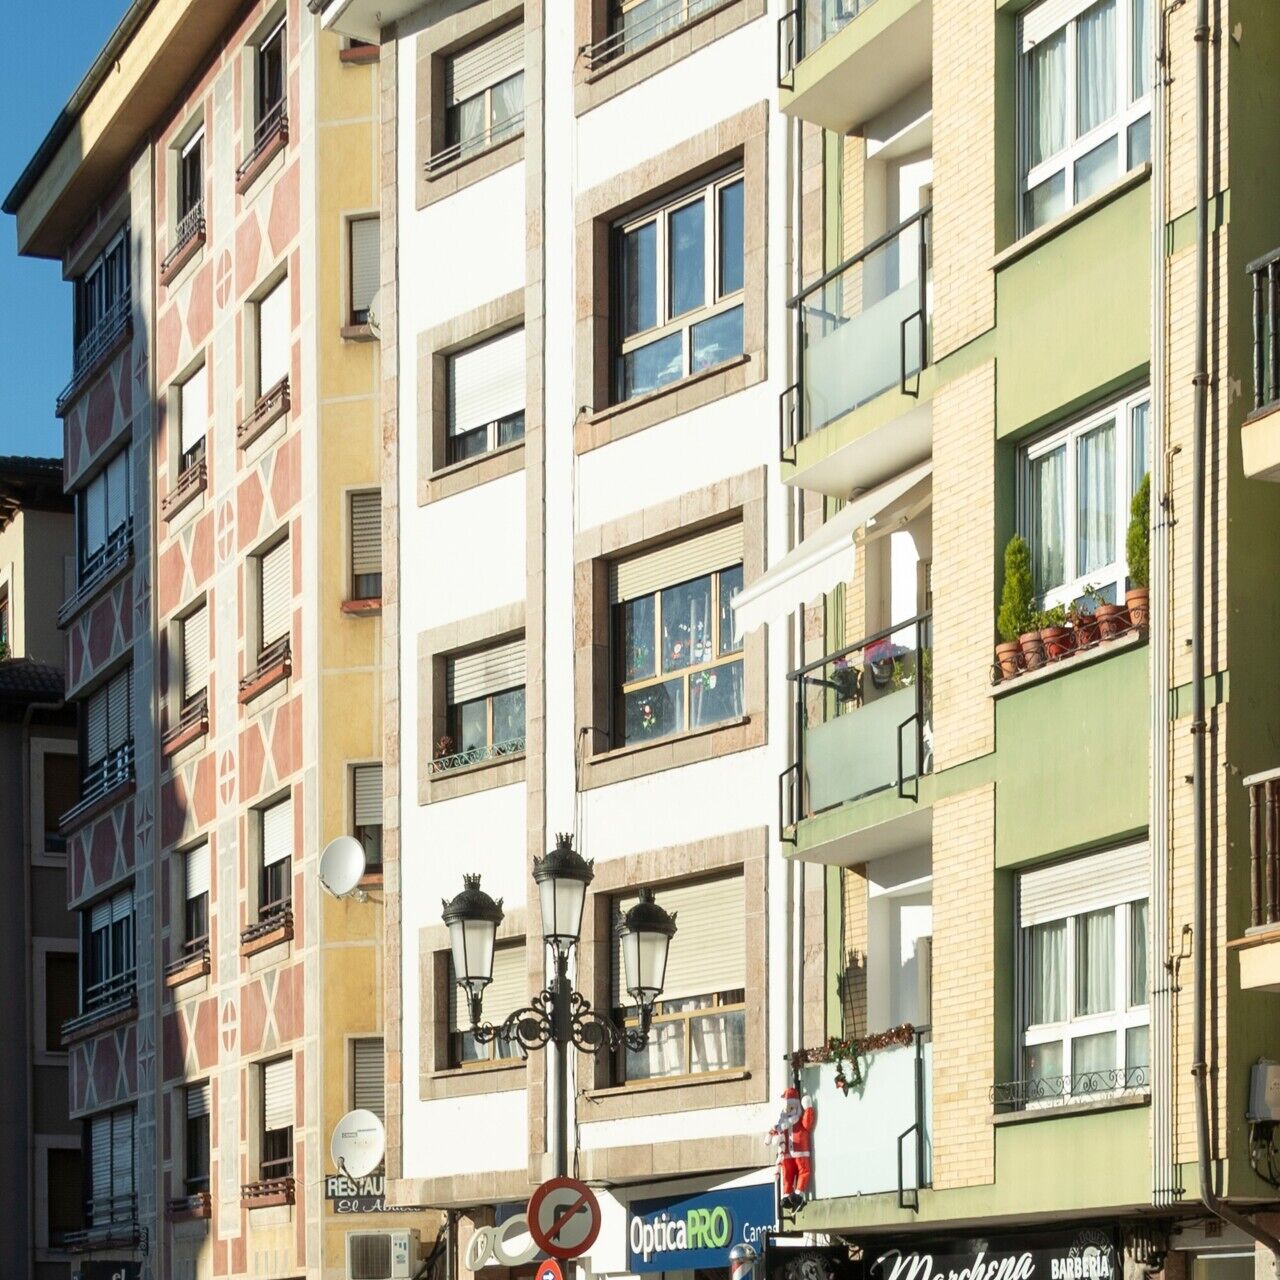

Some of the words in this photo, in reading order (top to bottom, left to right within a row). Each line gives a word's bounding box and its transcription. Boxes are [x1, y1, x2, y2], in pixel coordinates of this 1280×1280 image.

[327, 1176, 386, 1197] RESTAU
[337, 1199, 359, 1213] El
[630, 1206, 730, 1262] OpticaPRO
[1051, 1249, 1110, 1280] BARBERÍA
